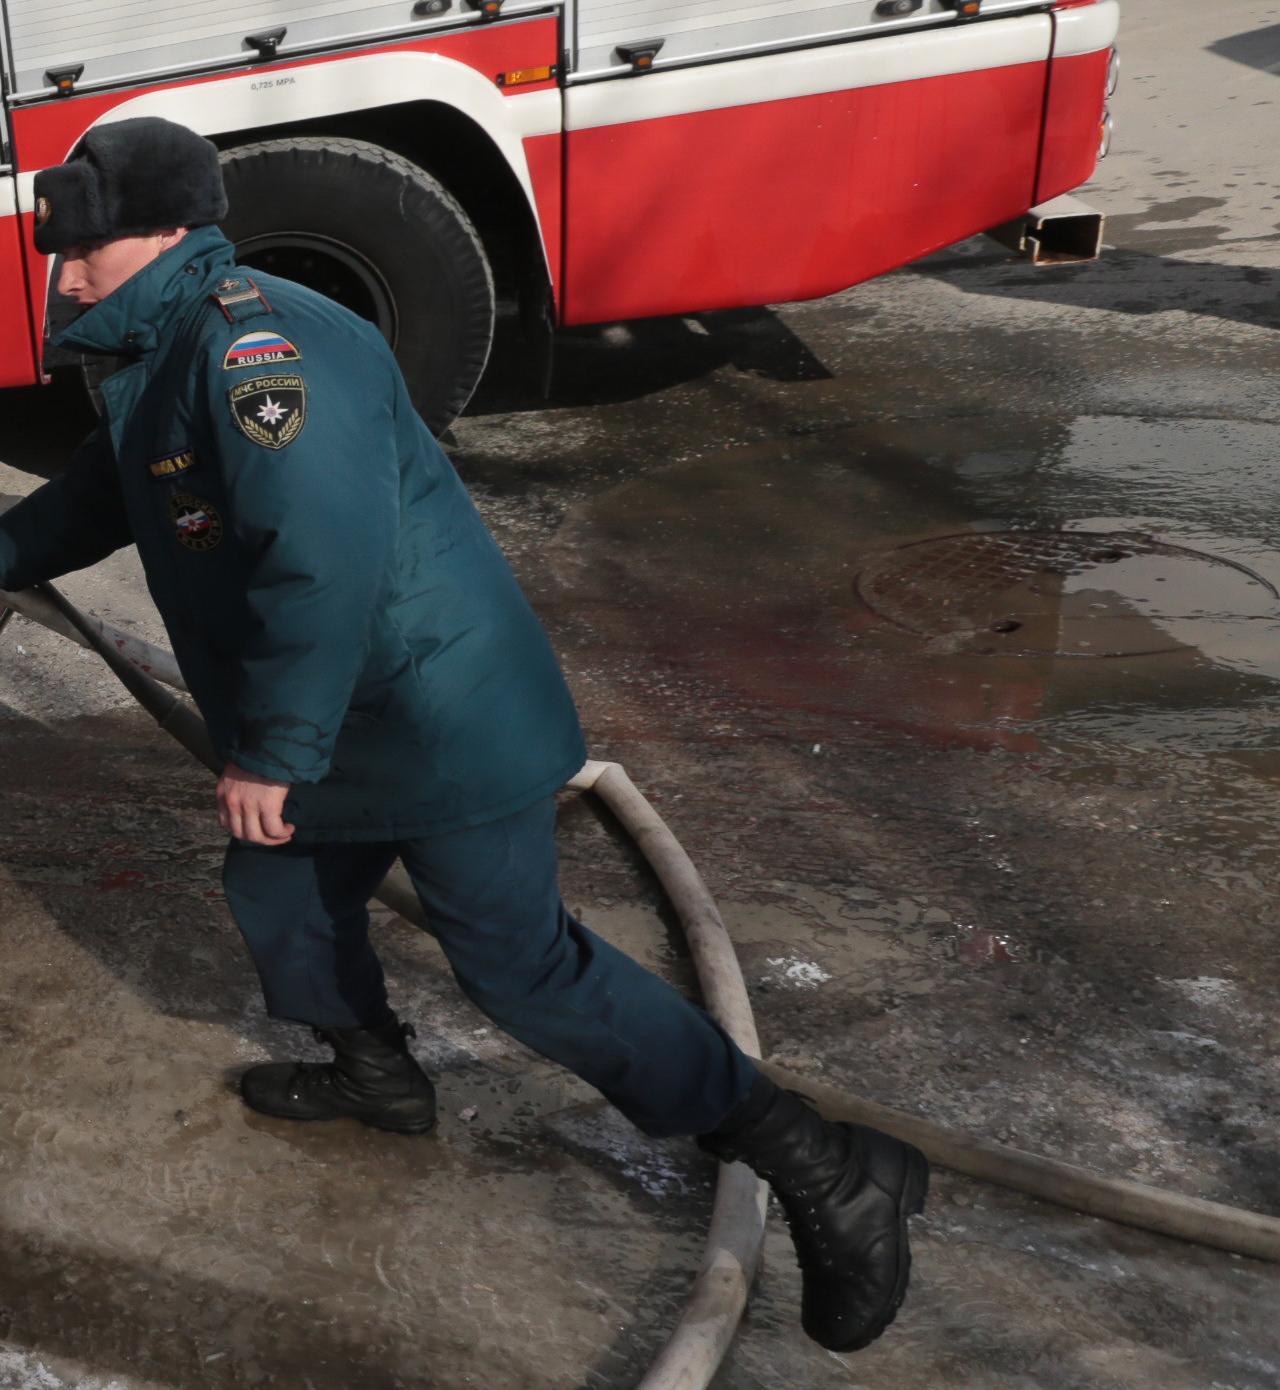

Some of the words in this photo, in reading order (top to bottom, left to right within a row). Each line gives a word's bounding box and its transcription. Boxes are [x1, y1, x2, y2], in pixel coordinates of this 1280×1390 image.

[238, 351, 285, 365] RUSSIA
[234, 382, 254, 397] МЧС
[256, 377, 300, 389] РОССИИ
